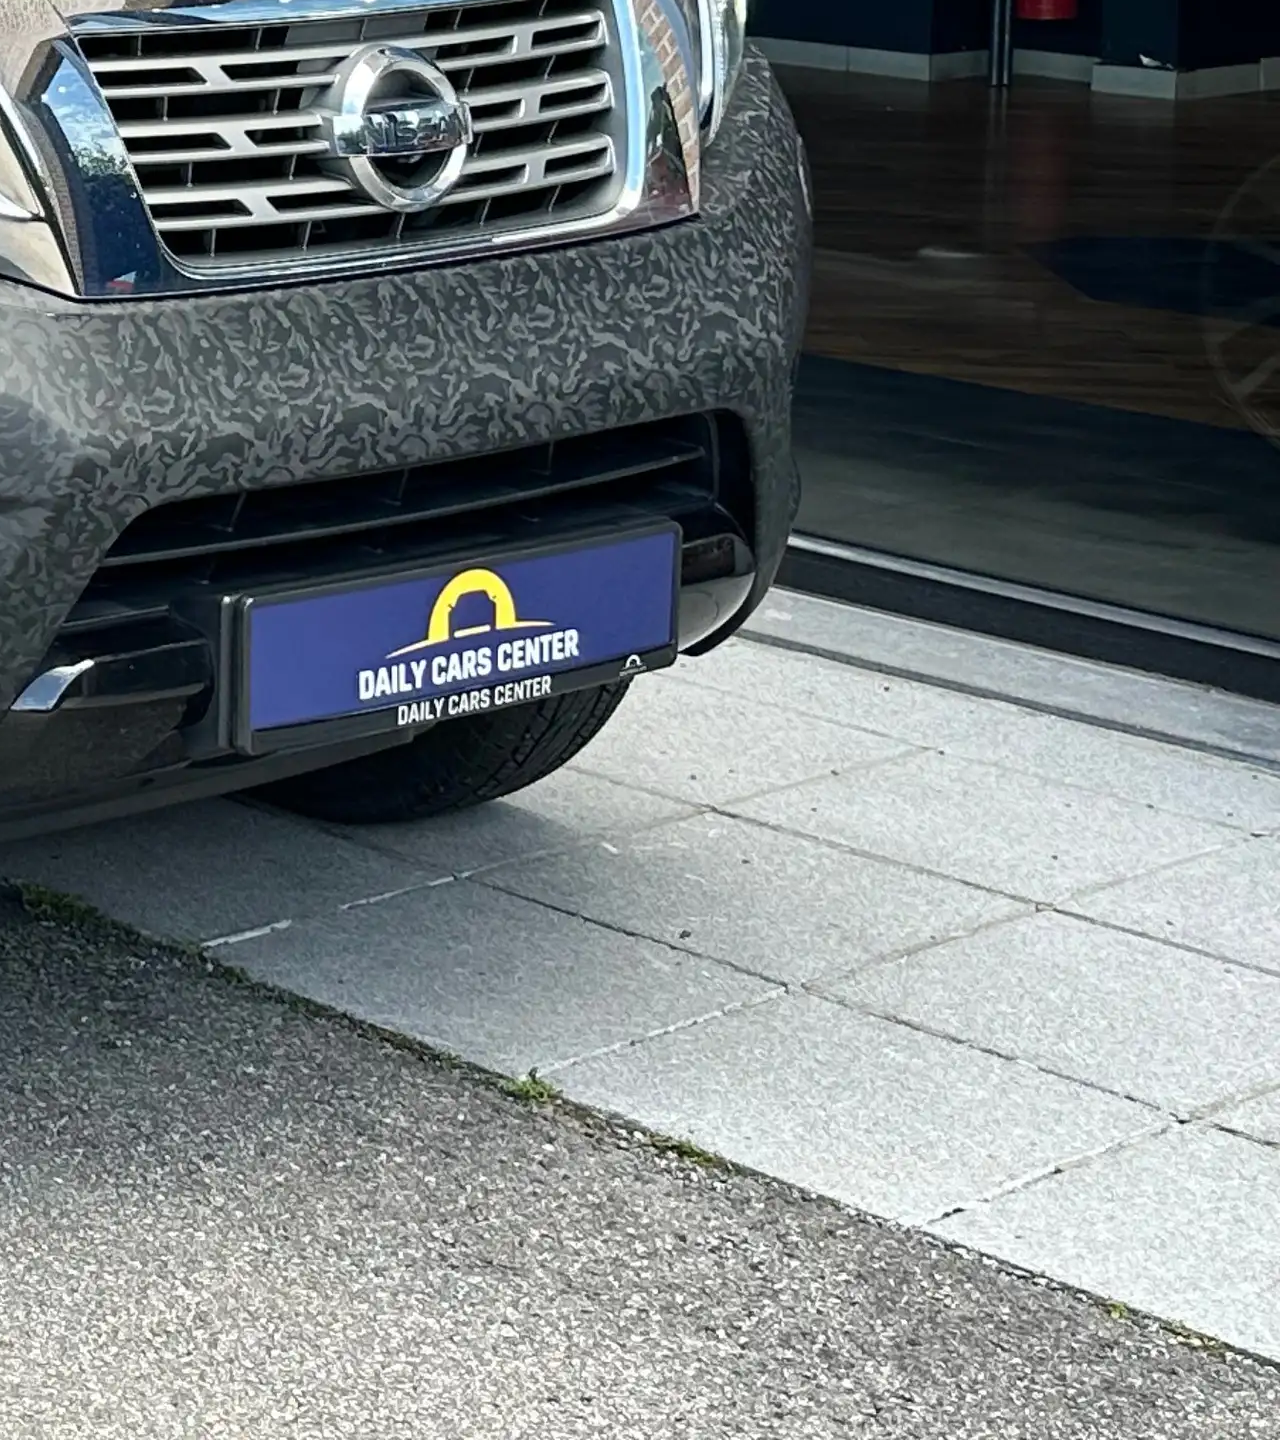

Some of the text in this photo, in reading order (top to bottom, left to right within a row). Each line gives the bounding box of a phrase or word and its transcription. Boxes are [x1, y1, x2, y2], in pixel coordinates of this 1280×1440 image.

[358, 628, 580, 701] DAILY CARS CENTER
[397, 674, 552, 726] DAILY CARS CENTER
